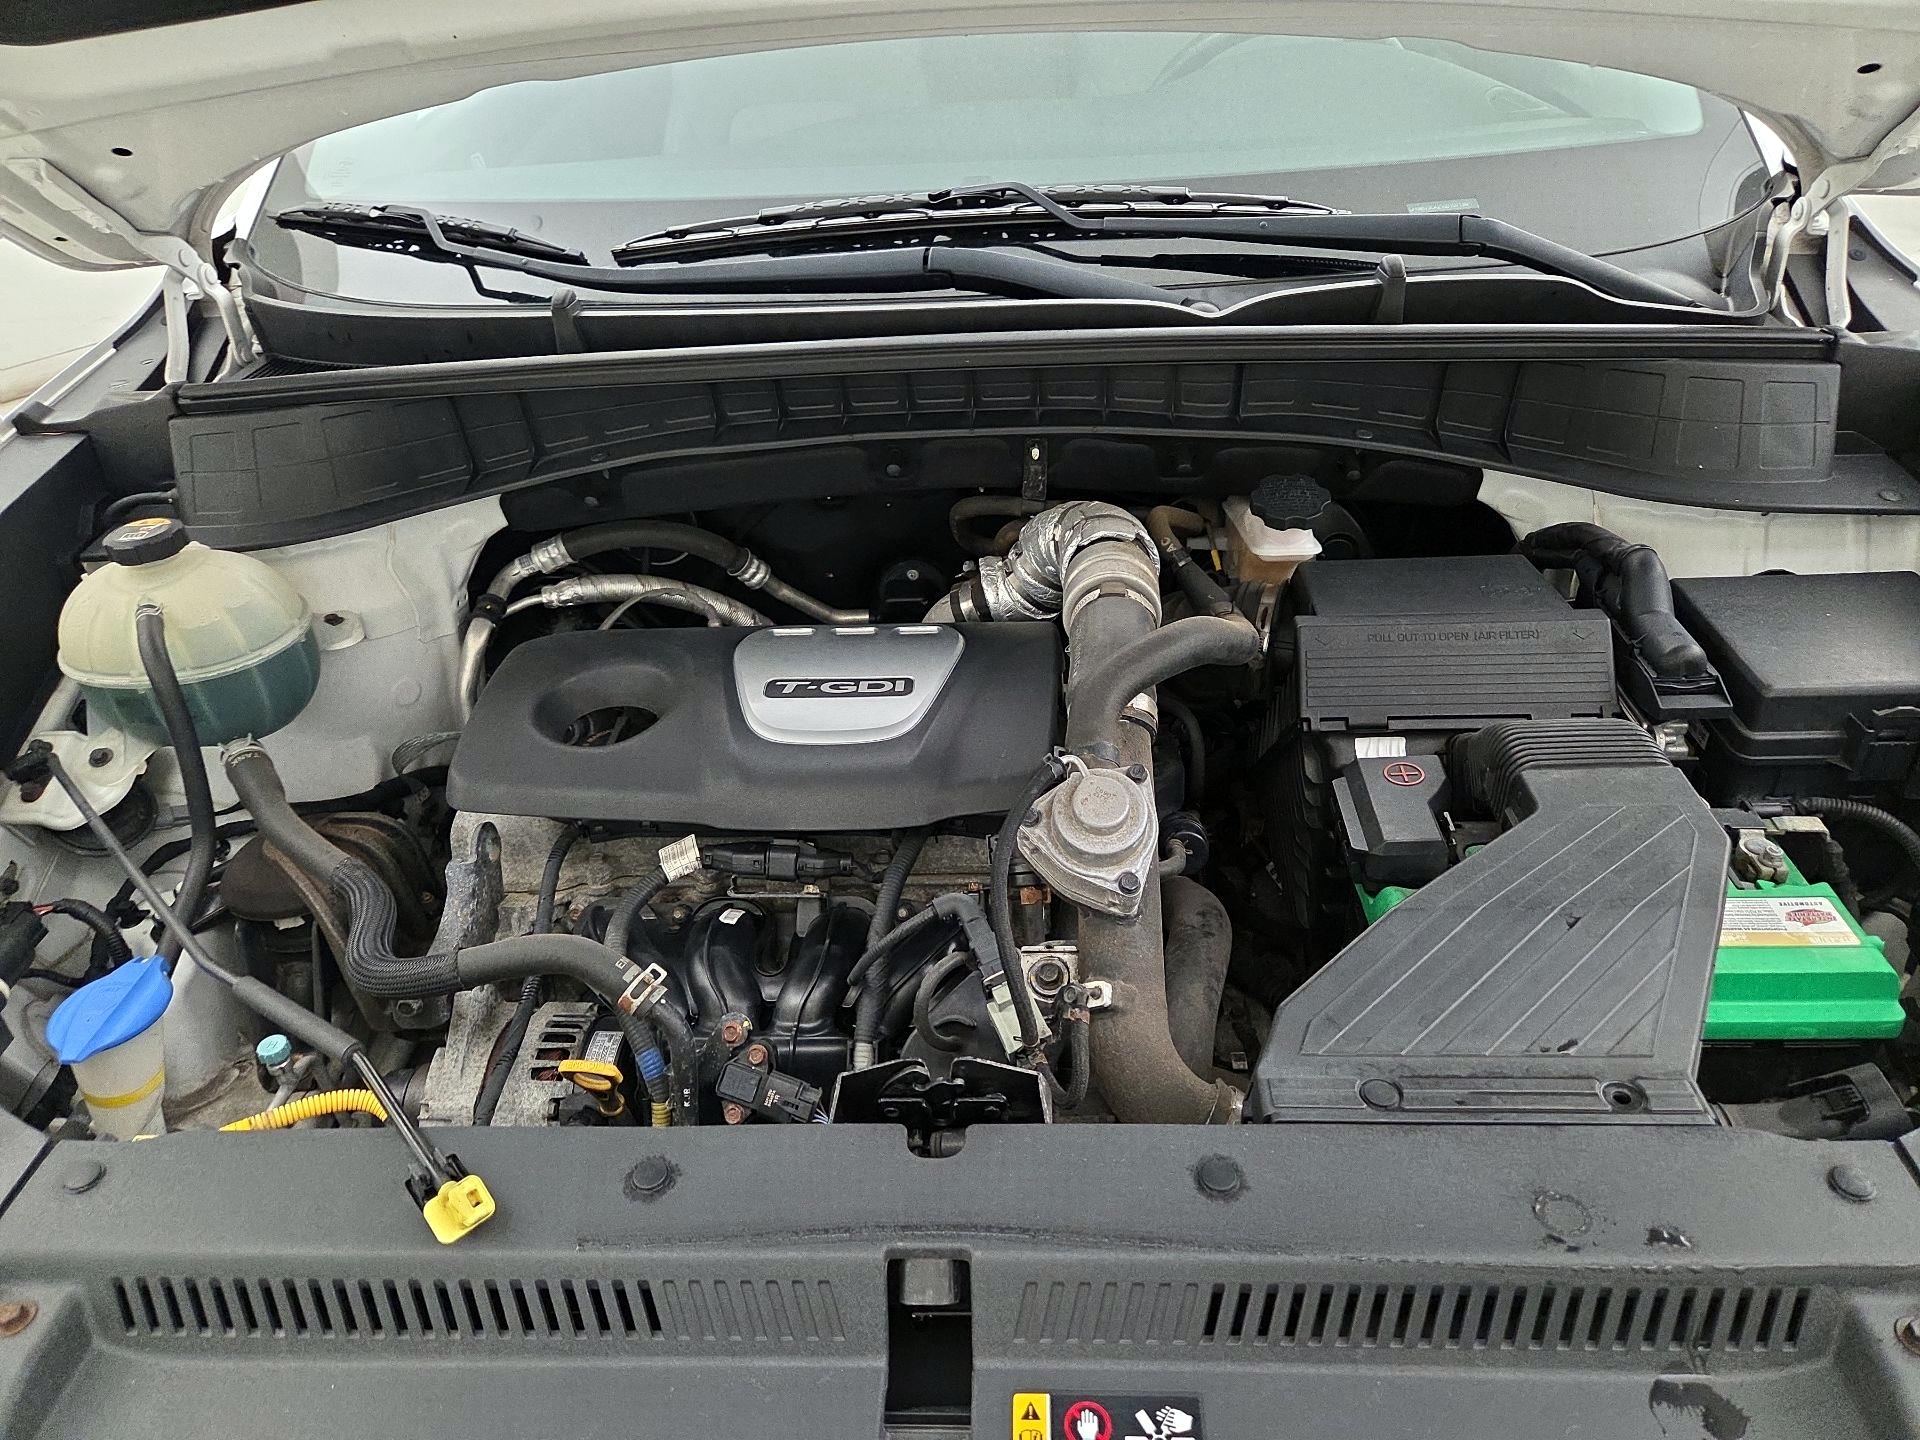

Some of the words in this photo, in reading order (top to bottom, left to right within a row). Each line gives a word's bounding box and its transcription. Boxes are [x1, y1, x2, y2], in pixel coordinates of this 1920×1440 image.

[1397, 632, 1418, 642] OUT
[1419, 632, 1436, 642] TO
[1439, 631, 1469, 641] OPEN
[775, 680, 905, 694] T-GDI
